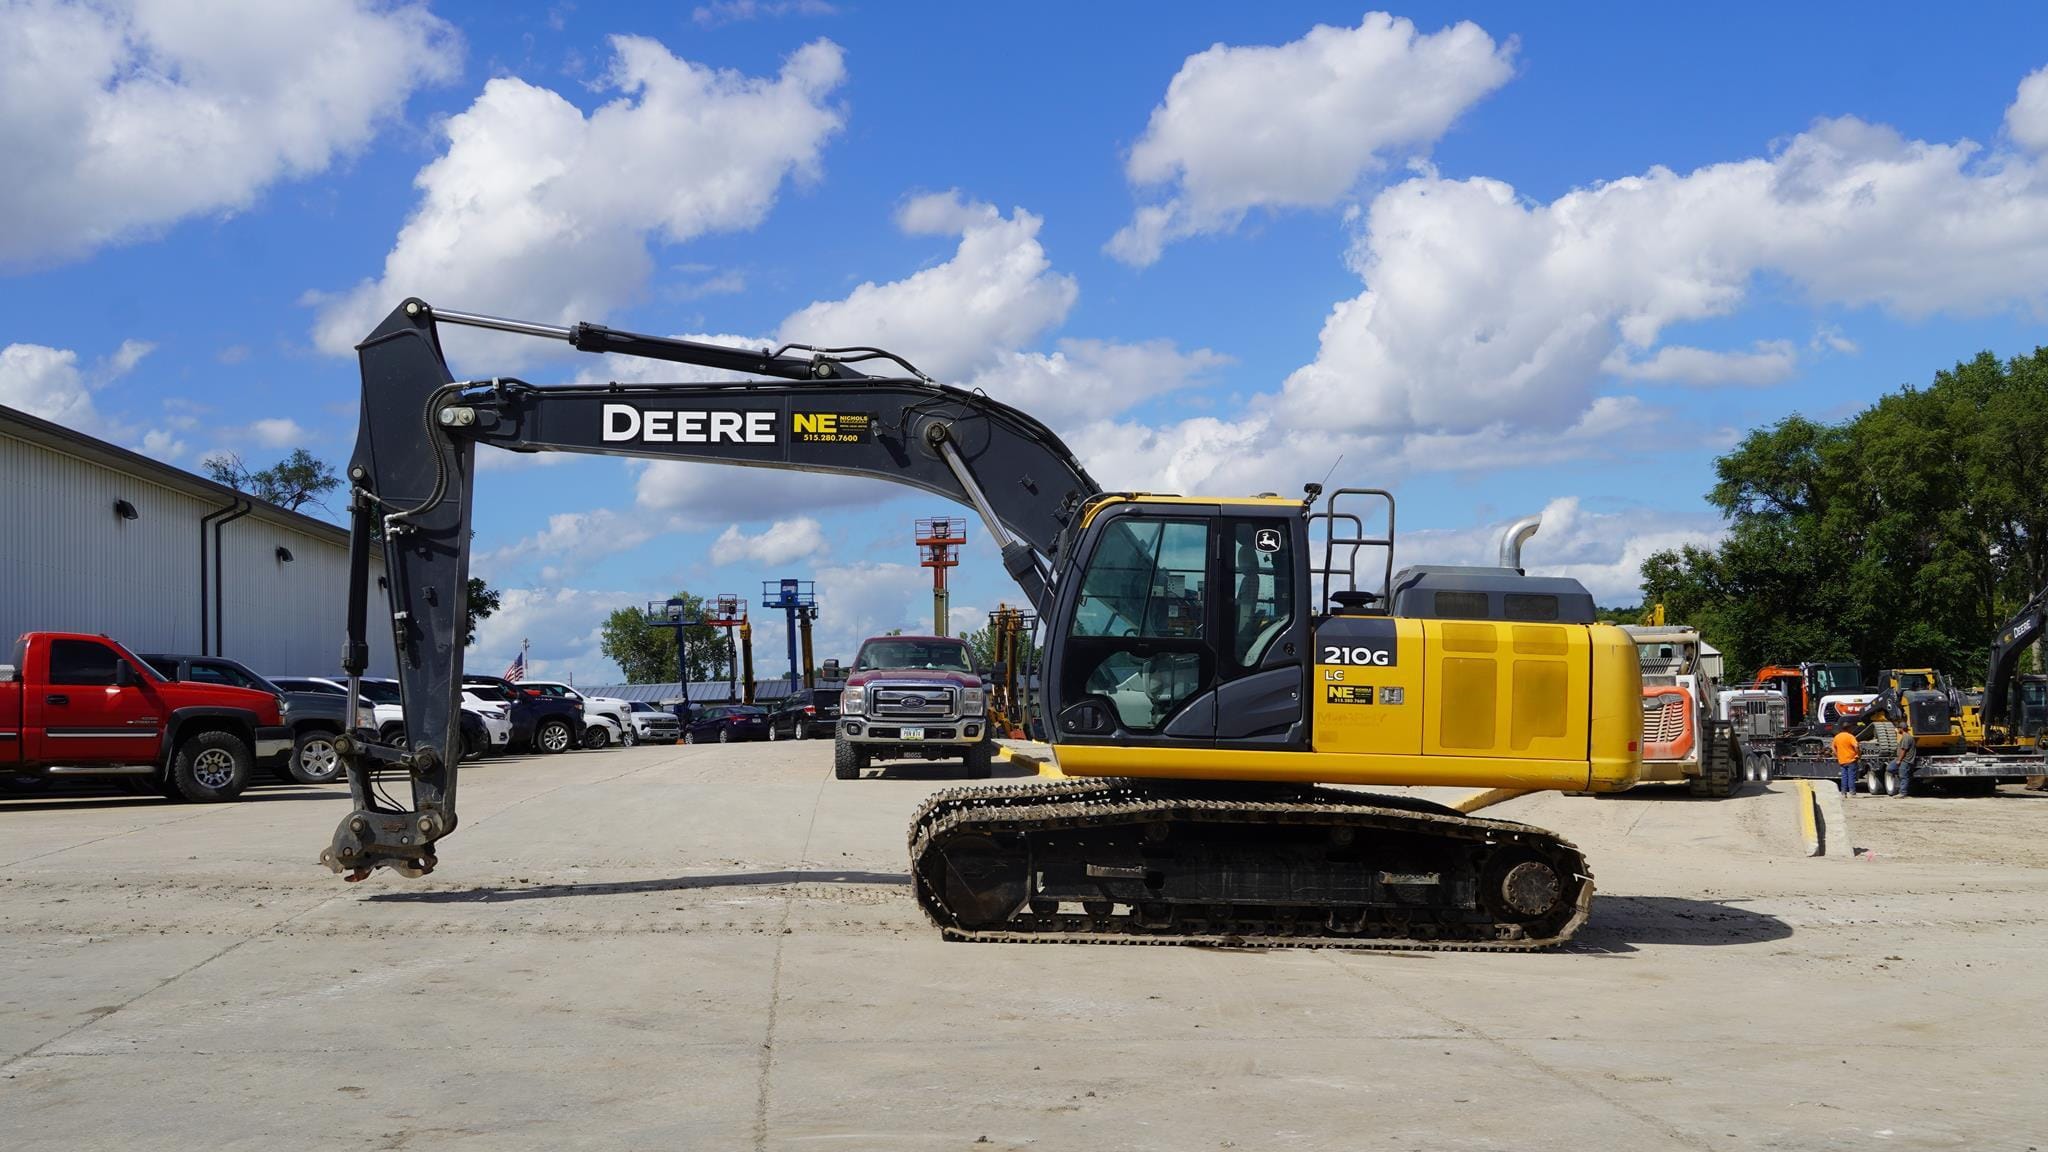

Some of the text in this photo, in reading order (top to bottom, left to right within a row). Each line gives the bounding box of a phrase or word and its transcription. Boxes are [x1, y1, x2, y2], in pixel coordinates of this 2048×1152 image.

[602, 403, 776, 443] DEERE
[793, 414, 838, 433] NE
[803, 434, 858, 442] 515.280.7600
[2013, 619, 2032, 639] DEERE
[1324, 646, 1389, 665] 210G
[1325, 670, 1344, 681] LC
[1329, 686, 1354, 698] NE
